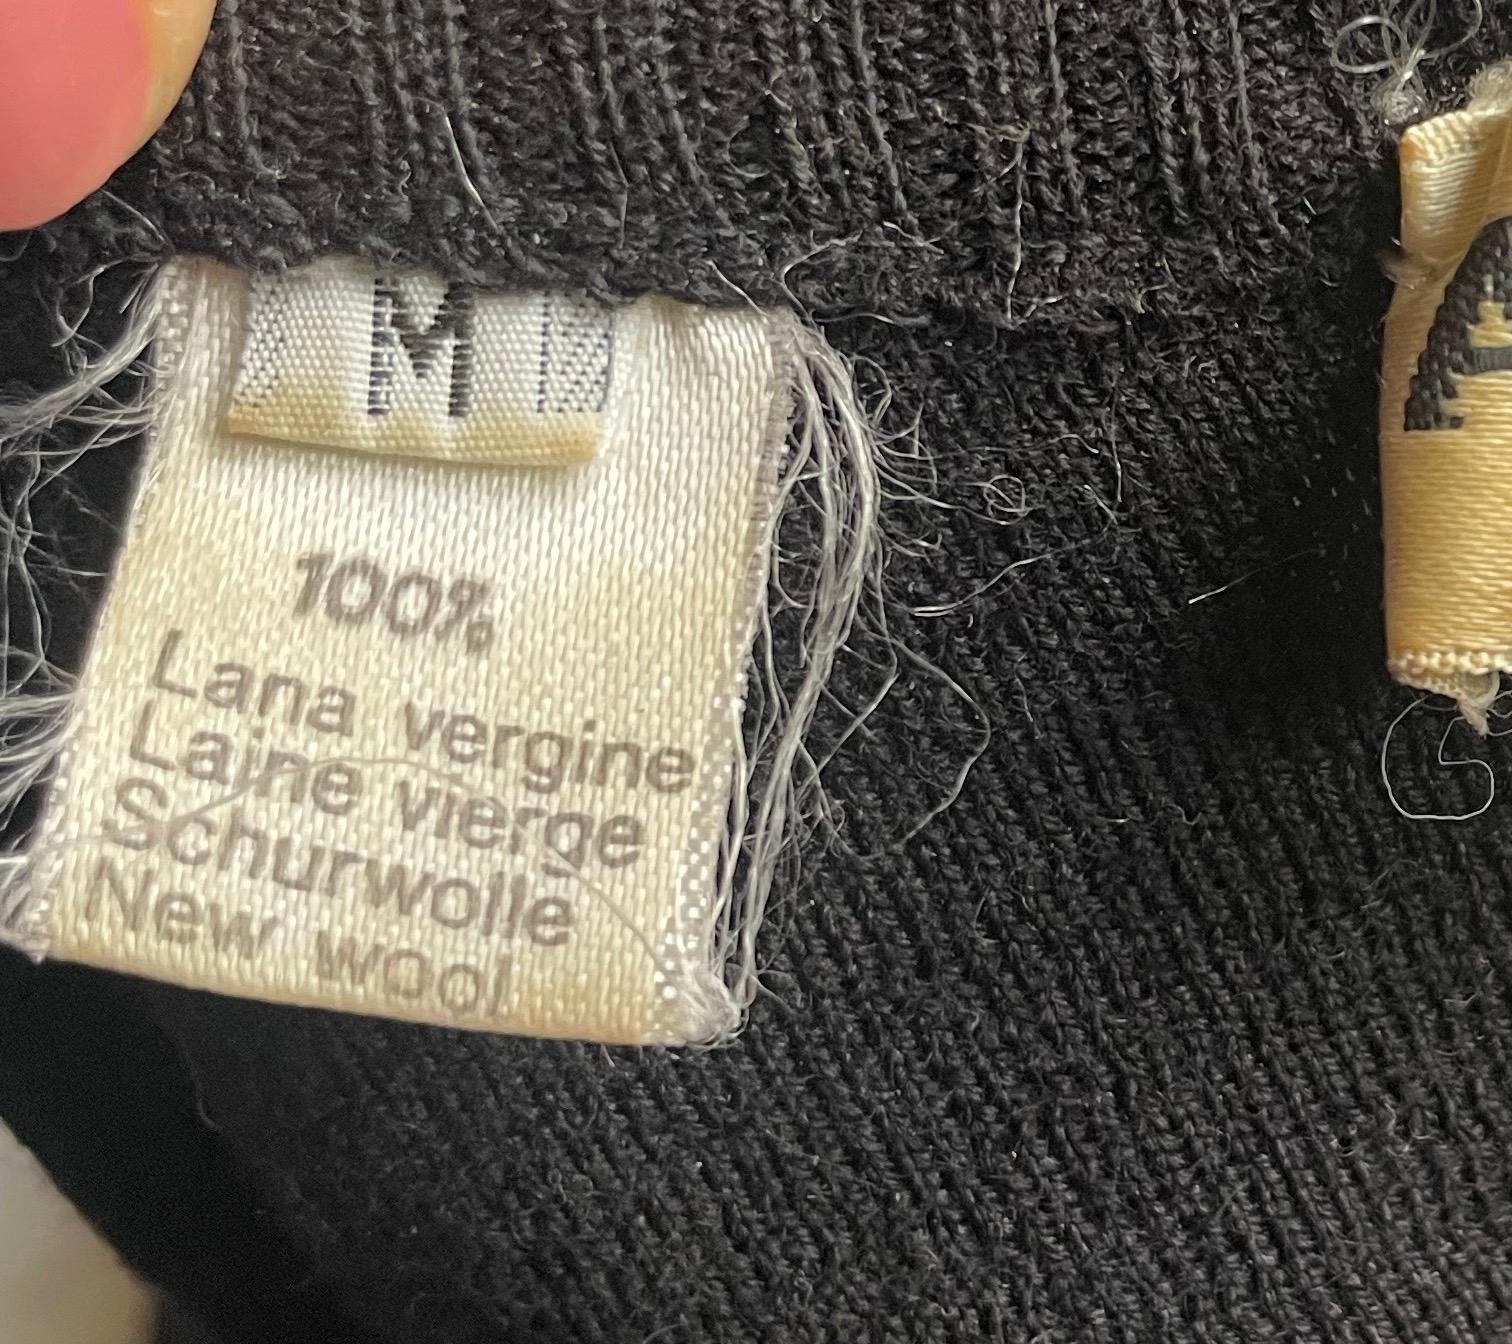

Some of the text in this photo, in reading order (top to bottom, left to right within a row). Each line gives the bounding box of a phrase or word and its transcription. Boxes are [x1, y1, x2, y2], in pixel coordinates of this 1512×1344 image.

[367, 274, 474, 417] M
[295, 551, 498, 649] 100%
[129, 700, 647, 878] Laine vierge
[151, 628, 697, 795] Lana vergine
[84, 860, 514, 1017] New wool
[102, 775, 576, 947] Schurwolle
